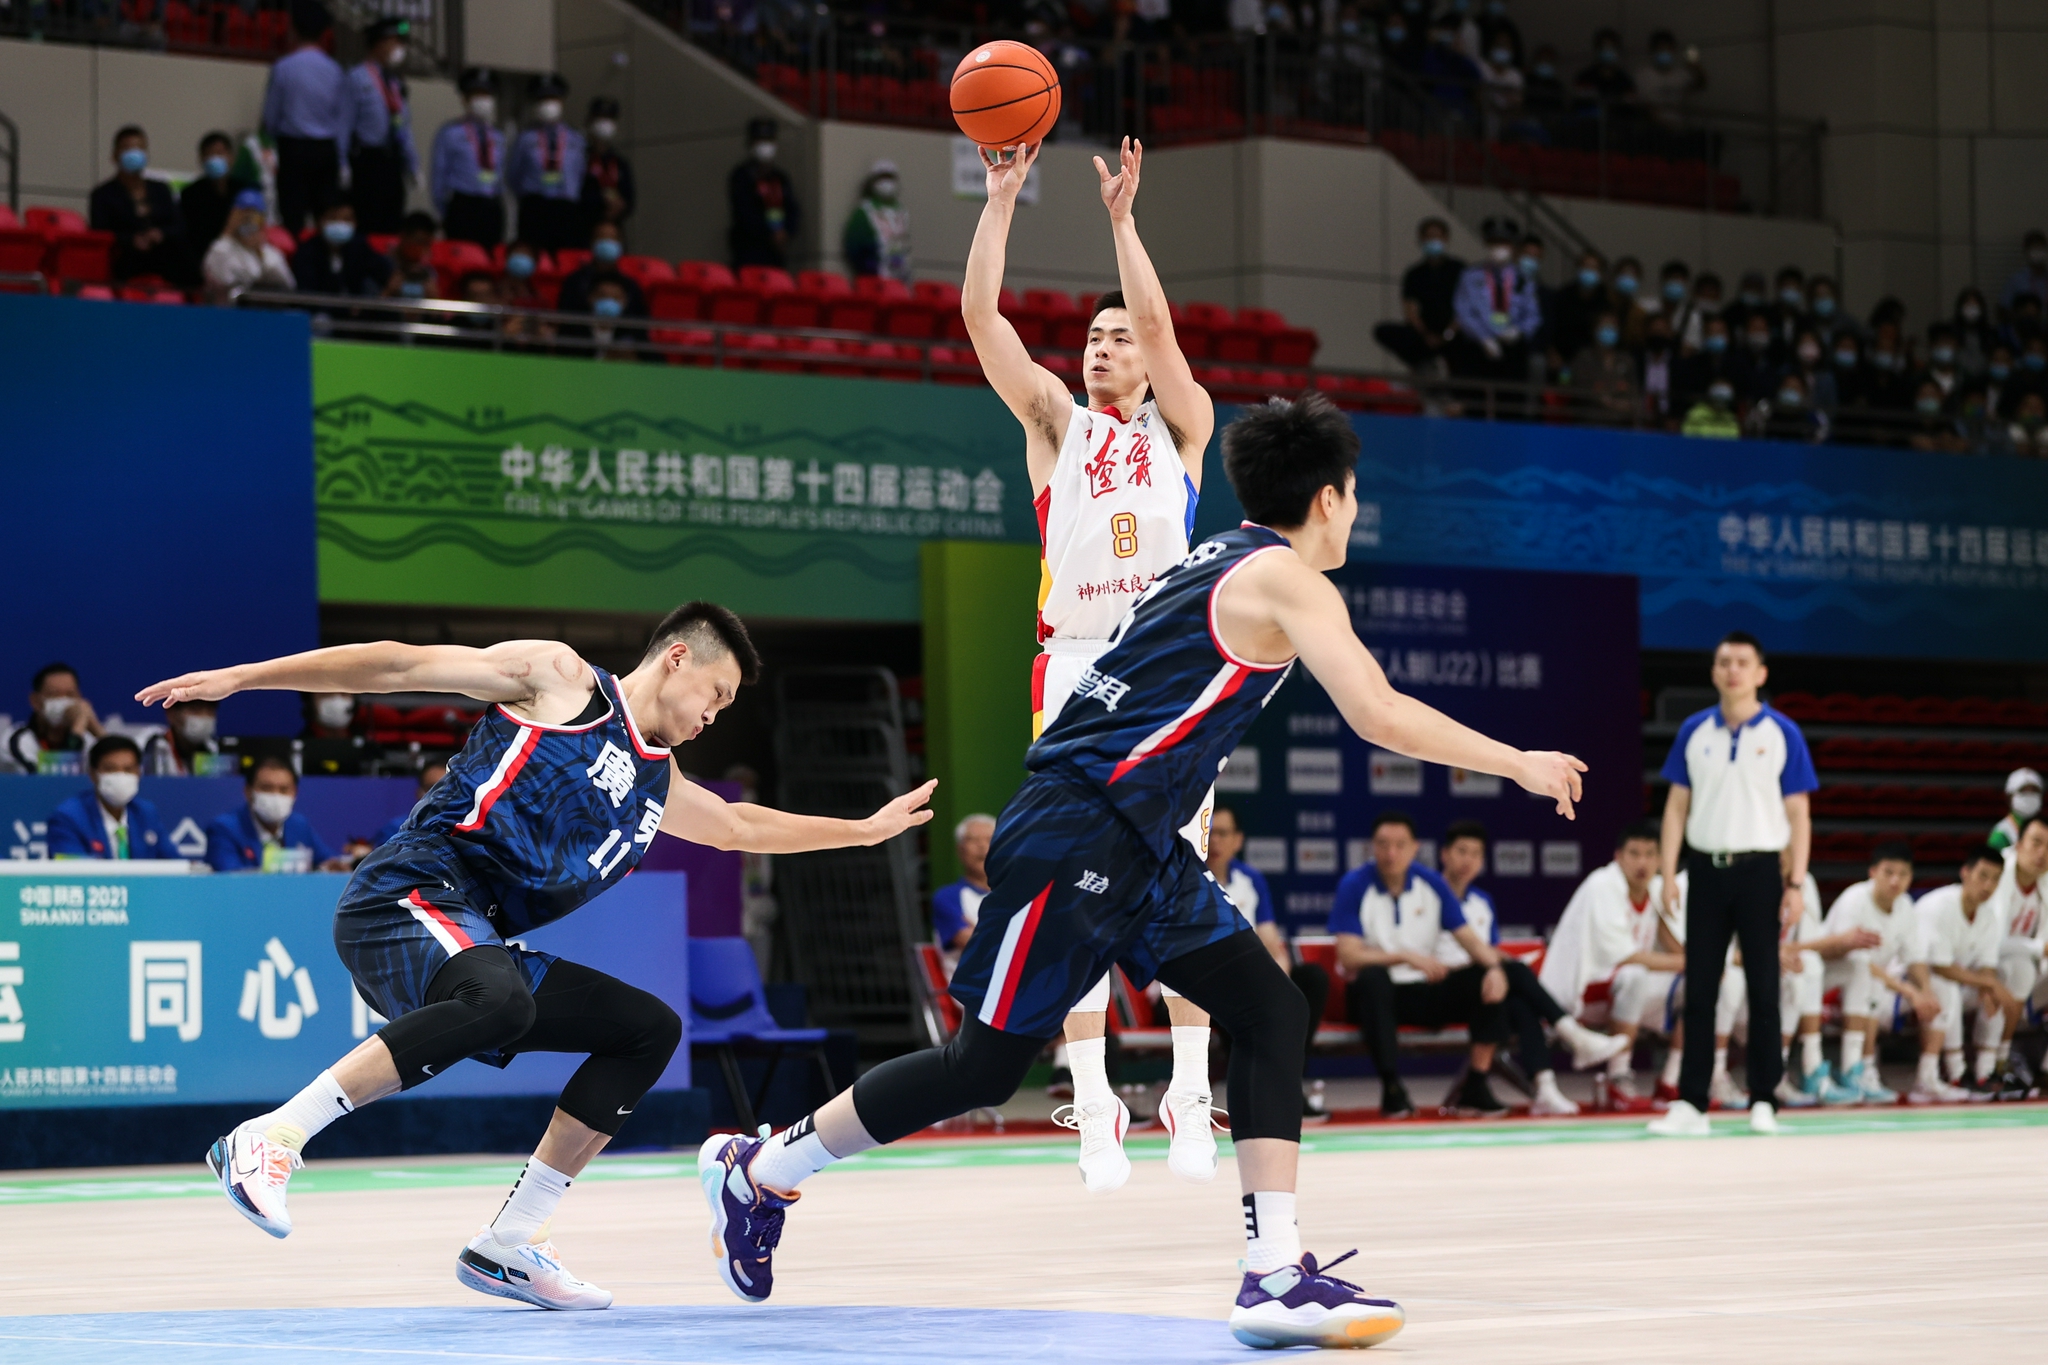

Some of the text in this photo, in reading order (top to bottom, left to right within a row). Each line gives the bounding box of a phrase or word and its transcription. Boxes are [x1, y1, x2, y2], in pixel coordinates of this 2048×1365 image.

[501, 443, 1004, 513] 中华人民共和国第十四届运动会
[1111, 512, 1138, 558] 8
[587, 829, 632, 881] 11
[19, 907, 129, 926] SHAANXI CHINA
[87, 885, 128, 907] 2021
